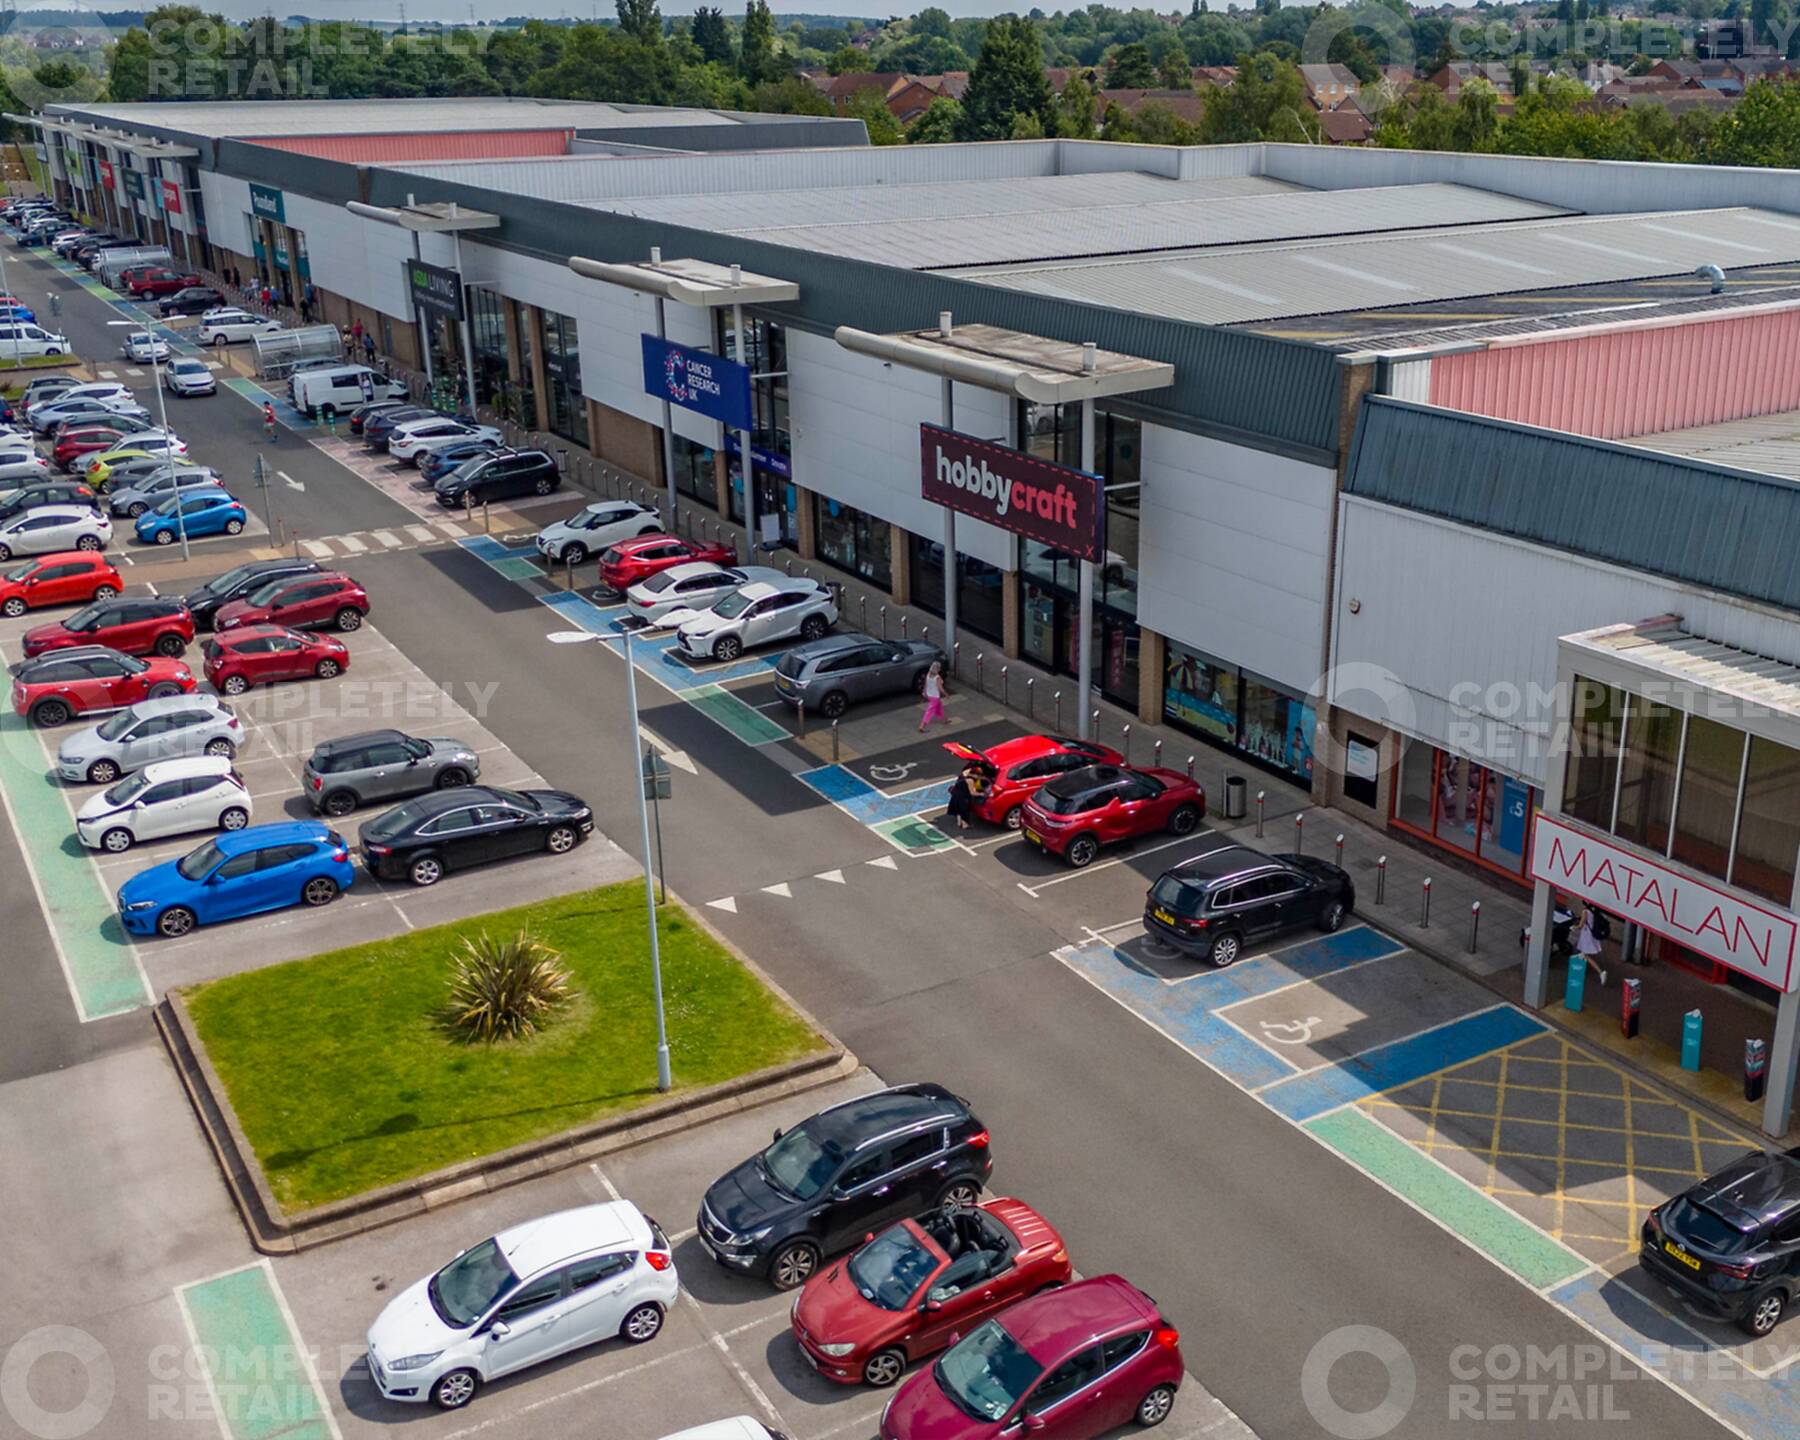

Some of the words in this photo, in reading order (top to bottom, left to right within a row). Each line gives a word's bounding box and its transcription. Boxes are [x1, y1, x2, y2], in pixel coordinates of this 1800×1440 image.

[687, 360, 713, 379] CANCER
[687, 374, 720, 395] RESEARCH
[688, 388, 699, 401] UK
[936, 445, 1077, 529] hobbycraft
[1548, 837, 1772, 967] MATALAN
